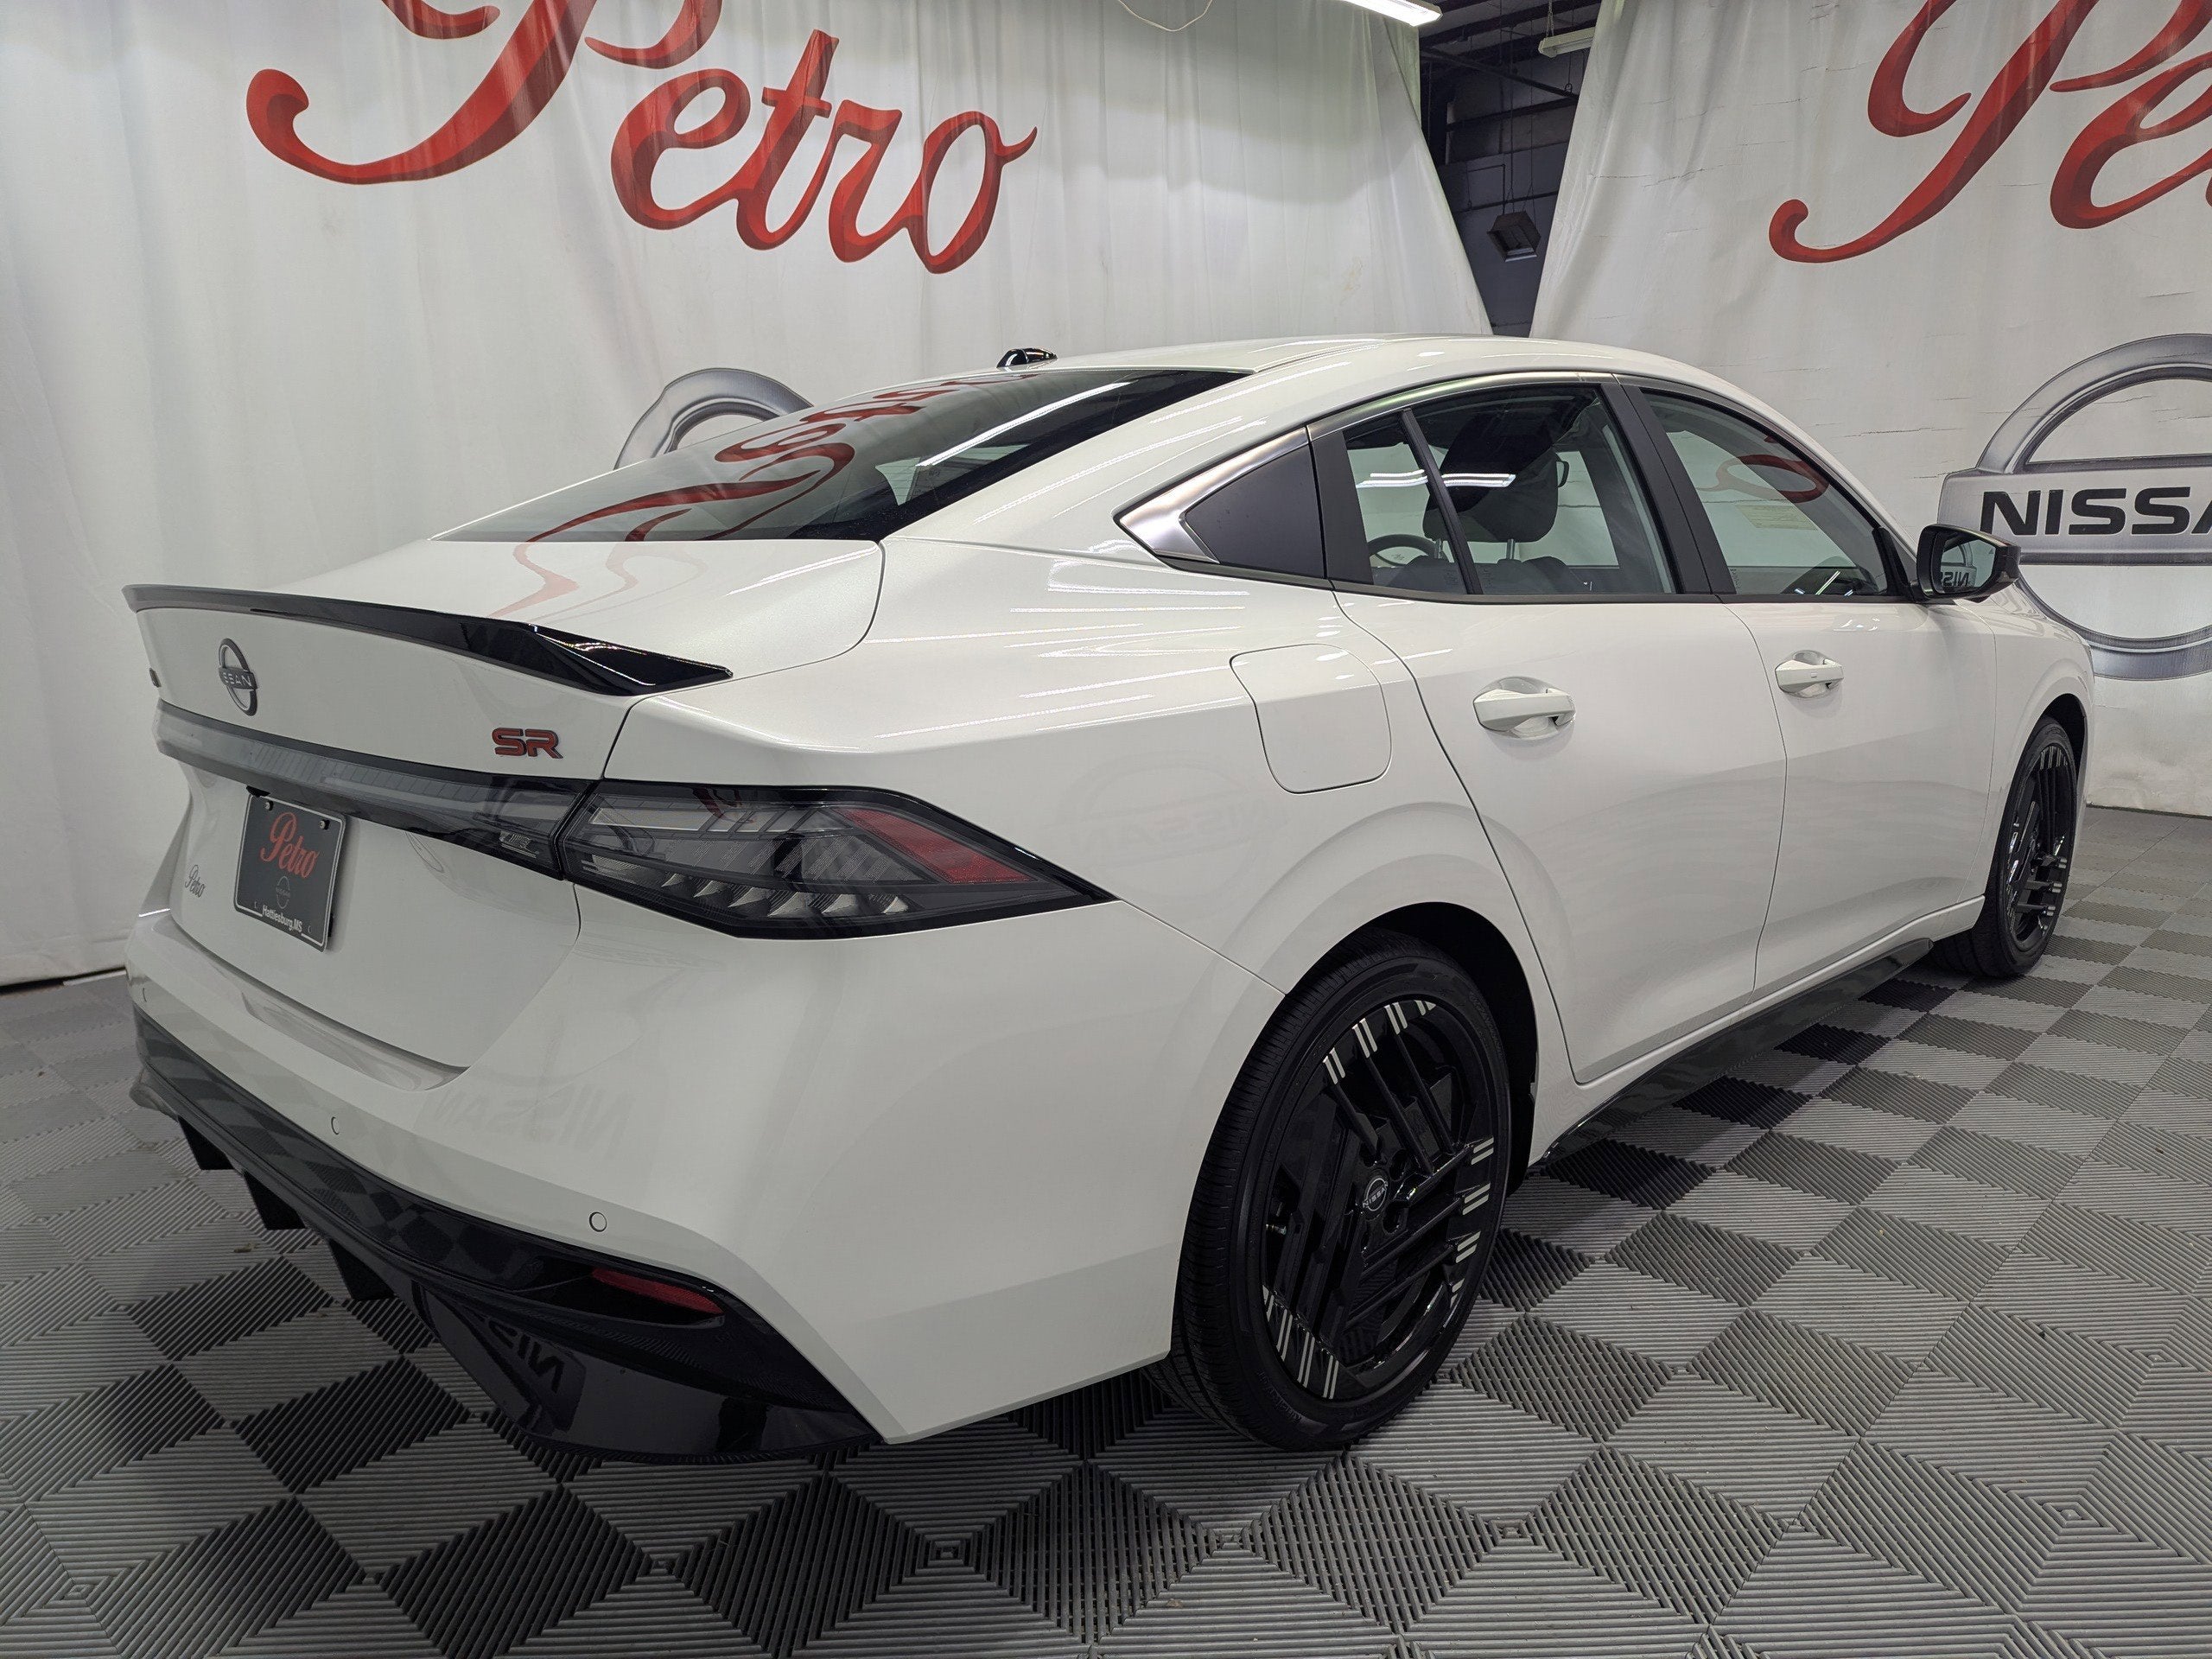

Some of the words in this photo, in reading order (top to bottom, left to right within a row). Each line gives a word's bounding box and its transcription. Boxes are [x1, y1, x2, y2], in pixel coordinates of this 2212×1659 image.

[492, 727, 563, 759] SR
[260, 811, 320, 879] Petro
[184, 864, 207, 898] Petro
